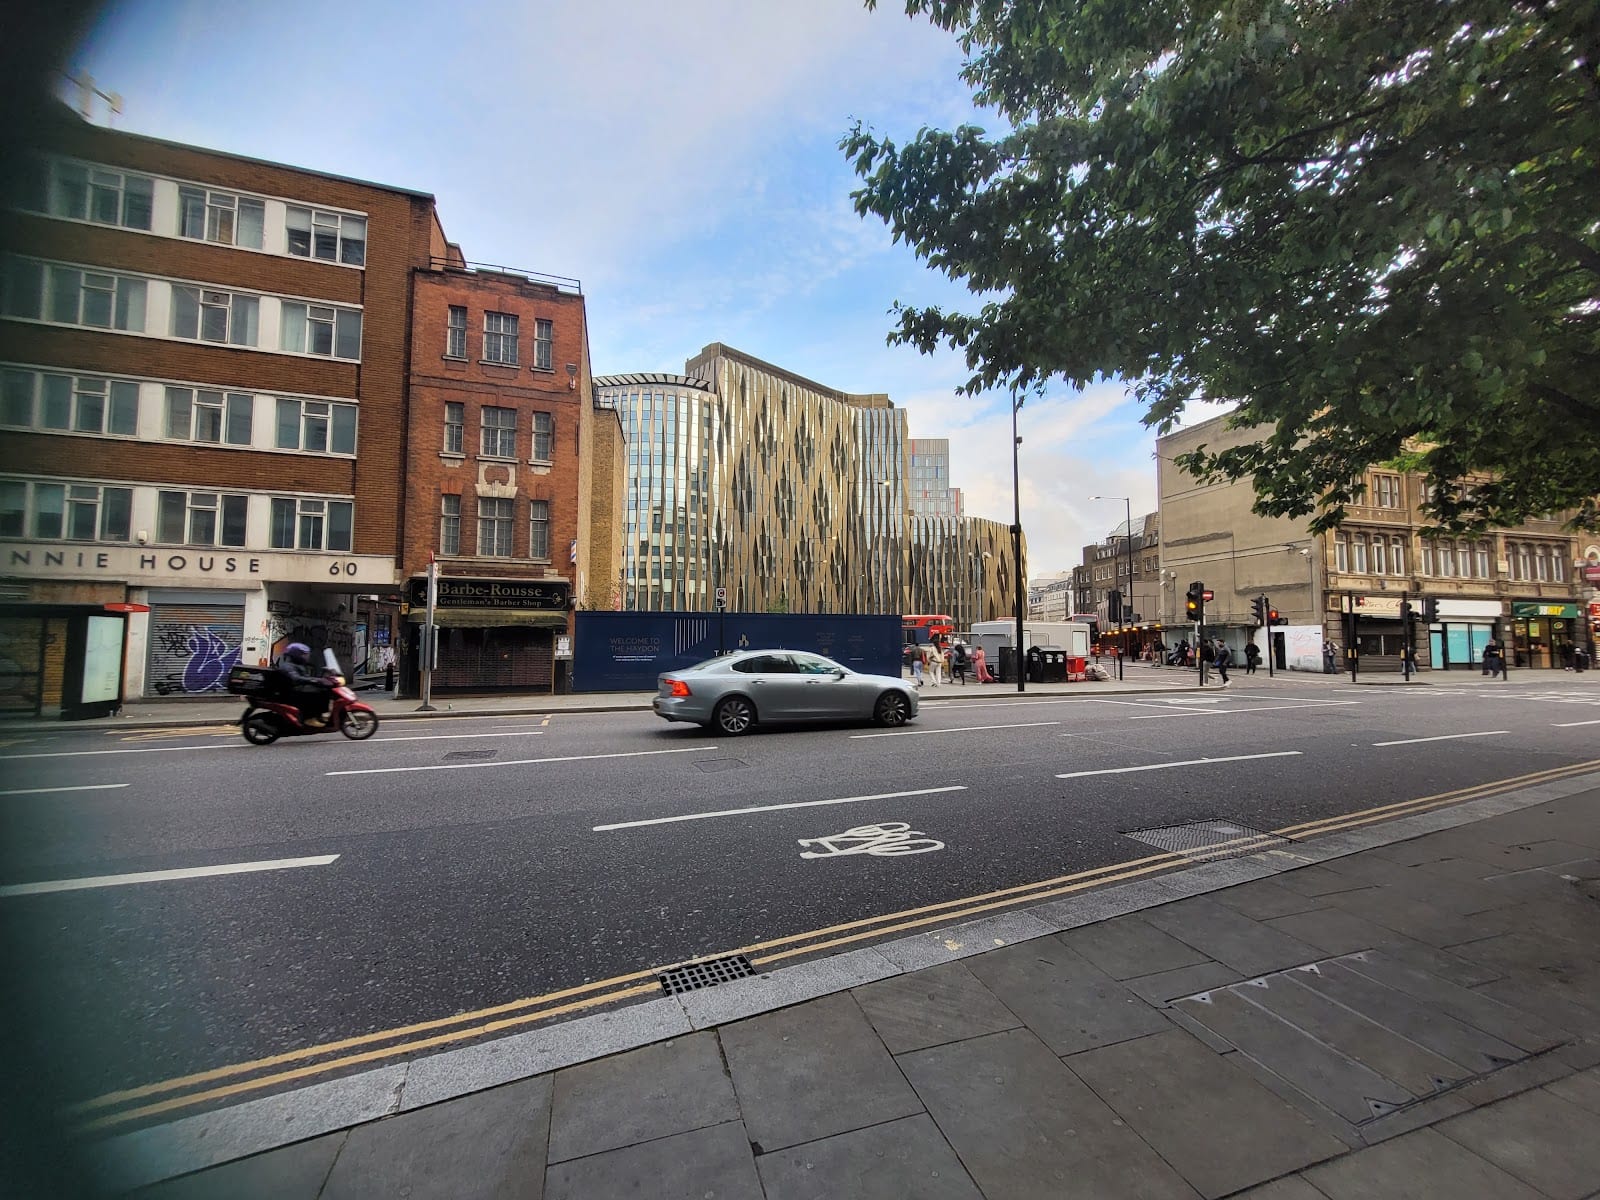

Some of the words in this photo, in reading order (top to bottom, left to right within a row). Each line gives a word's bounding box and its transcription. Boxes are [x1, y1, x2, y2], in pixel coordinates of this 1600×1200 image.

[140, 554, 259, 573] HOUSE
[329, 562, 358, 576] 60
[439, 582, 543, 597] Barbe-Rousse
[439, 597, 491, 606] Gentleman's
[522, 600, 542, 608] Shop
[610, 637, 649, 645] WELCOME
[650, 637, 660, 645] TO
